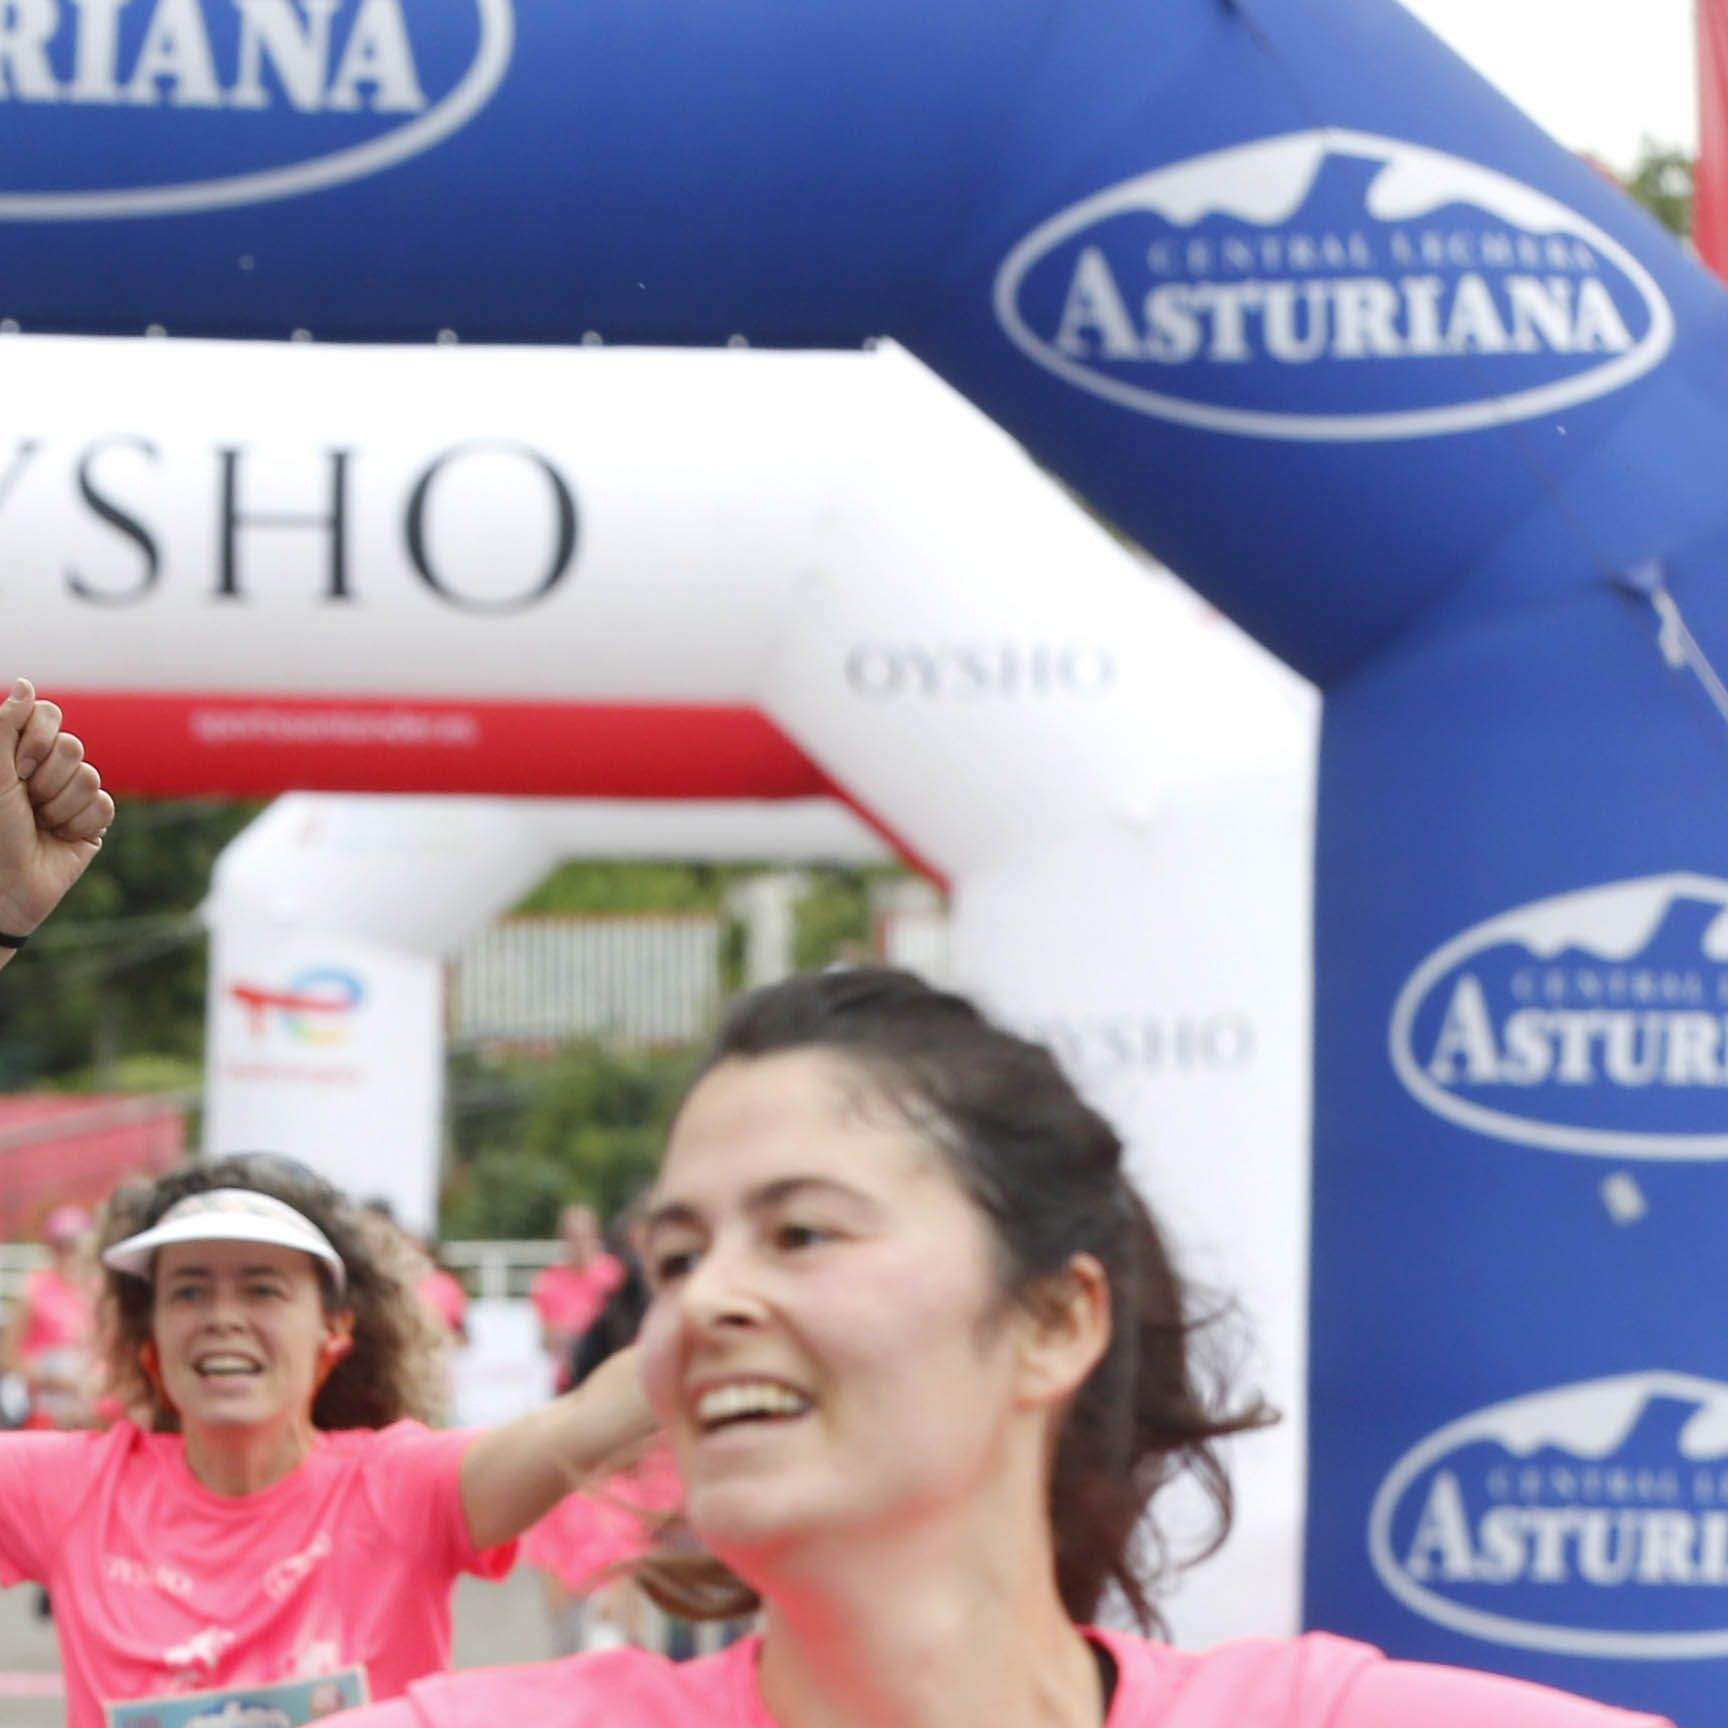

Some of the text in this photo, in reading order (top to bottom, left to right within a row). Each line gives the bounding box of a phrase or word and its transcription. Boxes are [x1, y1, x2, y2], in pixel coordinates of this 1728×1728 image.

[1054, 246, 1634, 363] ASTURIANA
[846, 638, 1119, 707] OYSHO
[1426, 974, 1728, 1088] ASTUR
